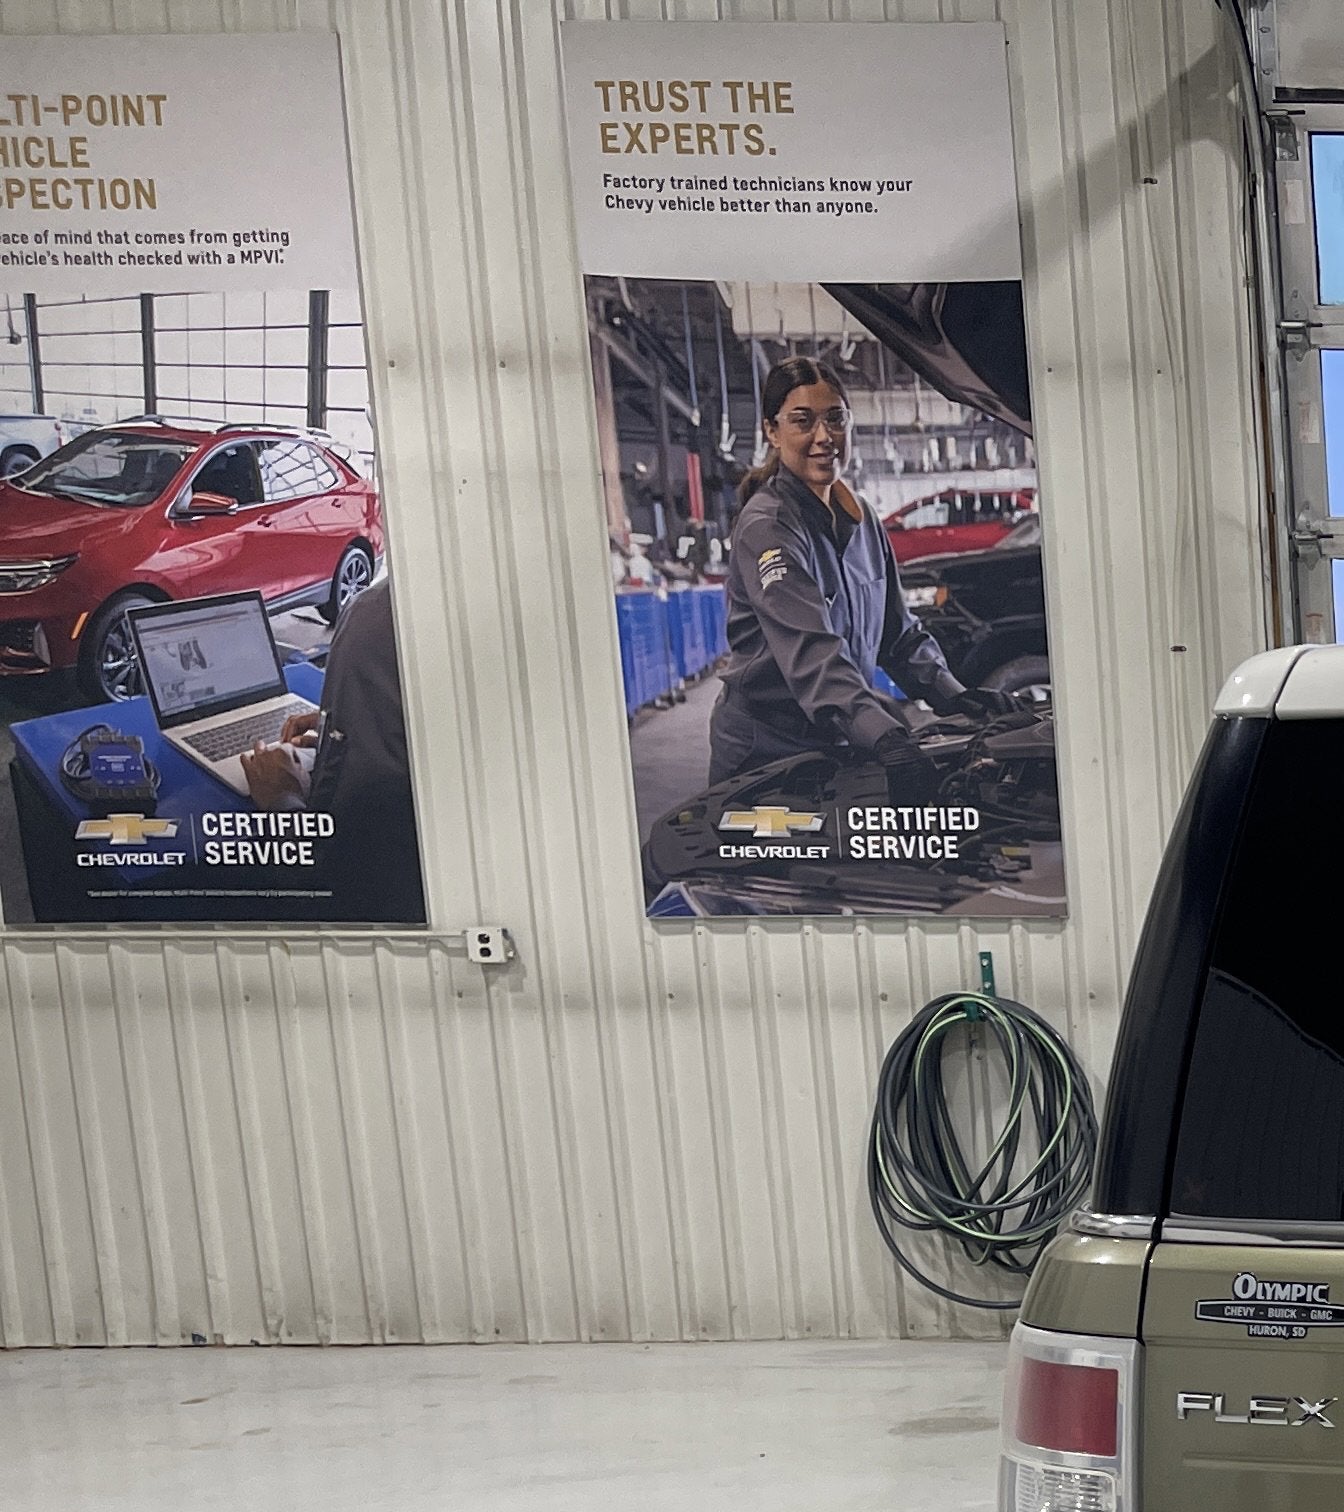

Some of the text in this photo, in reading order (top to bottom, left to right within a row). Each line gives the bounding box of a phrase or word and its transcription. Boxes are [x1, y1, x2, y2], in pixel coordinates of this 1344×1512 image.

[594, 80, 795, 114] TRUST THE
[600, 123, 777, 156] EXPERTS.
[0, 178, 157, 209] PECTION
[603, 174, 913, 196] Factory trained technicians know your
[605, 195, 878, 216] Chevy vehicle better than anyone.
[0, 229, 289, 248] ace of mind that comes from getting
[0, 251, 59, 265] ehicle's
[64, 251, 113, 265] health
[118, 251, 183, 265] checked
[188, 250, 221, 265] with
[227, 254, 236, 265] a
[202, 812, 335, 837] CERTIFIED
[848, 807, 980, 831] CERTIFIED
[205, 841, 315, 866] SERVICE
[719, 845, 830, 859] CHEVROLET
[850, 835, 959, 859] SERVICE
[77, 852, 186, 867] CHEVROLET
[1233, 1273, 1329, 1302] OLYMPIC
[1224, 1306, 1254, 1317] CHEVY
[1268, 1307, 1297, 1319] BUICK
[1310, 1309, 1333, 1321] GMC
[1249, 1324, 1306, 1337] HURON, SD
[1177, 1391, 1338, 1428] FLEX
